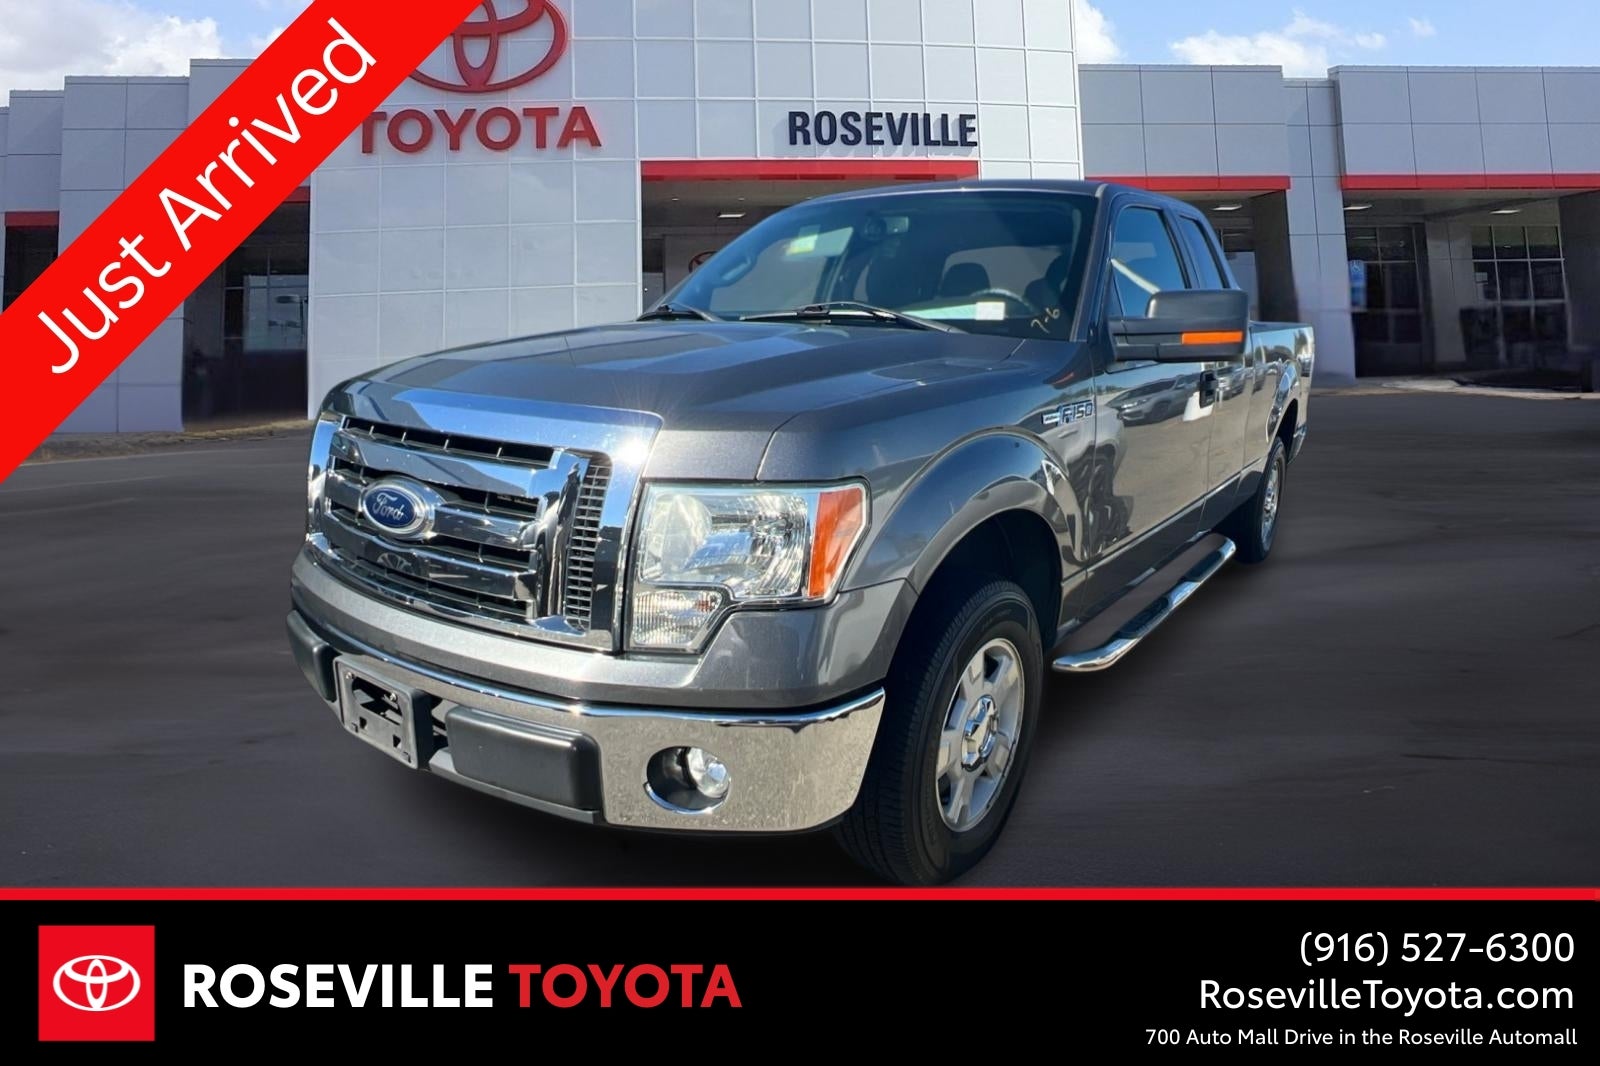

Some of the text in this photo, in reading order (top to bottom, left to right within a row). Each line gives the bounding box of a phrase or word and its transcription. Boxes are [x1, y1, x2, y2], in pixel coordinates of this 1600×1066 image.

[360, 106, 602, 154] TOYOTA
[788, 110, 978, 147] ROSEVILLE
[372, 492, 407, 520] Ford
